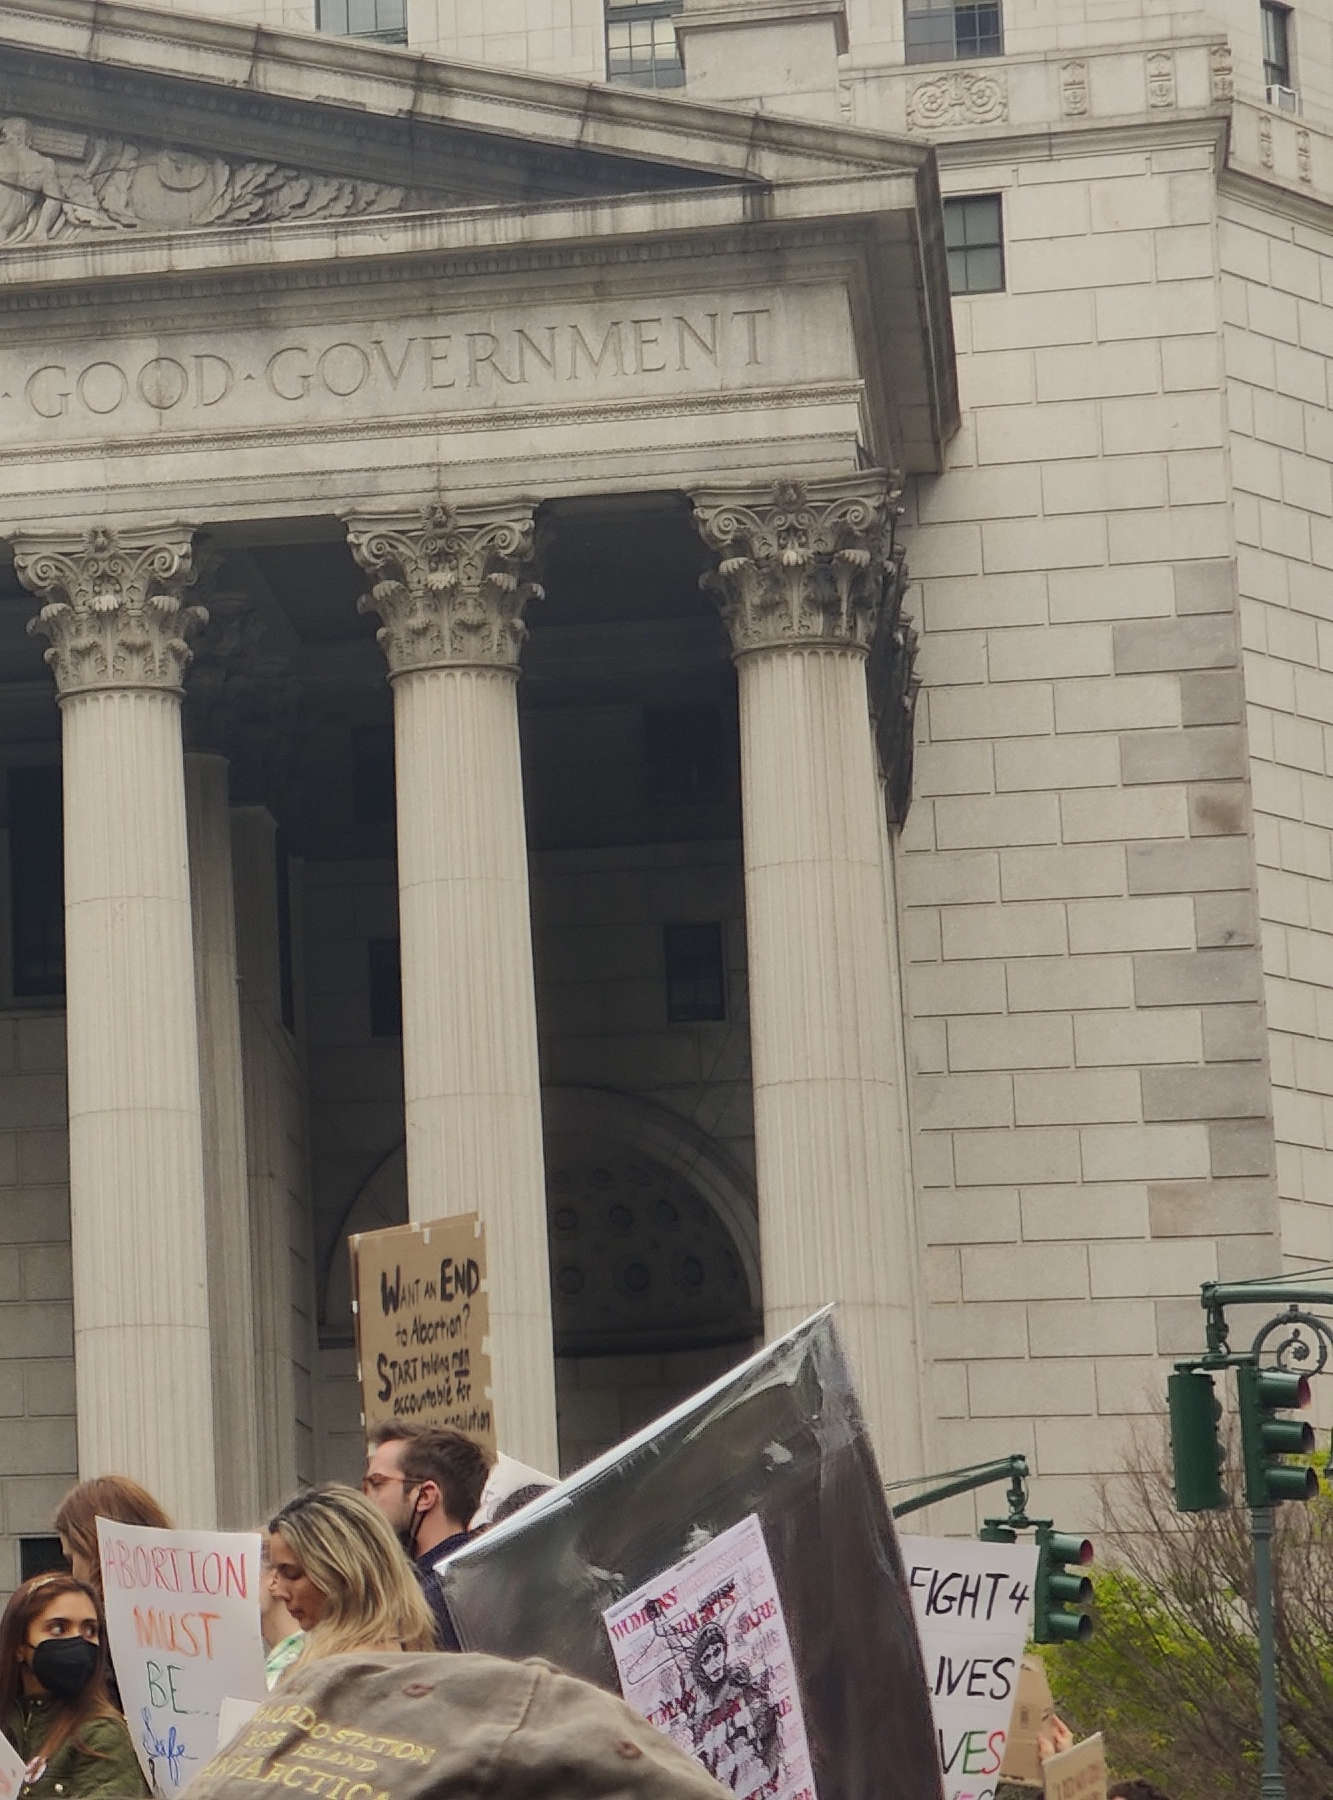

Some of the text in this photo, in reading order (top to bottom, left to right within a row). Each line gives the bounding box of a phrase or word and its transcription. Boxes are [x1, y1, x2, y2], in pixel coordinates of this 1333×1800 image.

[23, 353, 233, 420] GOOD
[264, 309, 771, 401] GOVERNMENT
[440, 1257, 480, 1302] END
[395, 1322, 408, 1347] to
[102, 1537, 248, 1599] ABORTION
[1008, 1581, 1030, 1615] 4
[133, 1605, 222, 1661] MUST
[933, 1655, 1016, 1701] IVES
[331, 1728, 436, 1766] STATION
[938, 1728, 1007, 1776] VES
